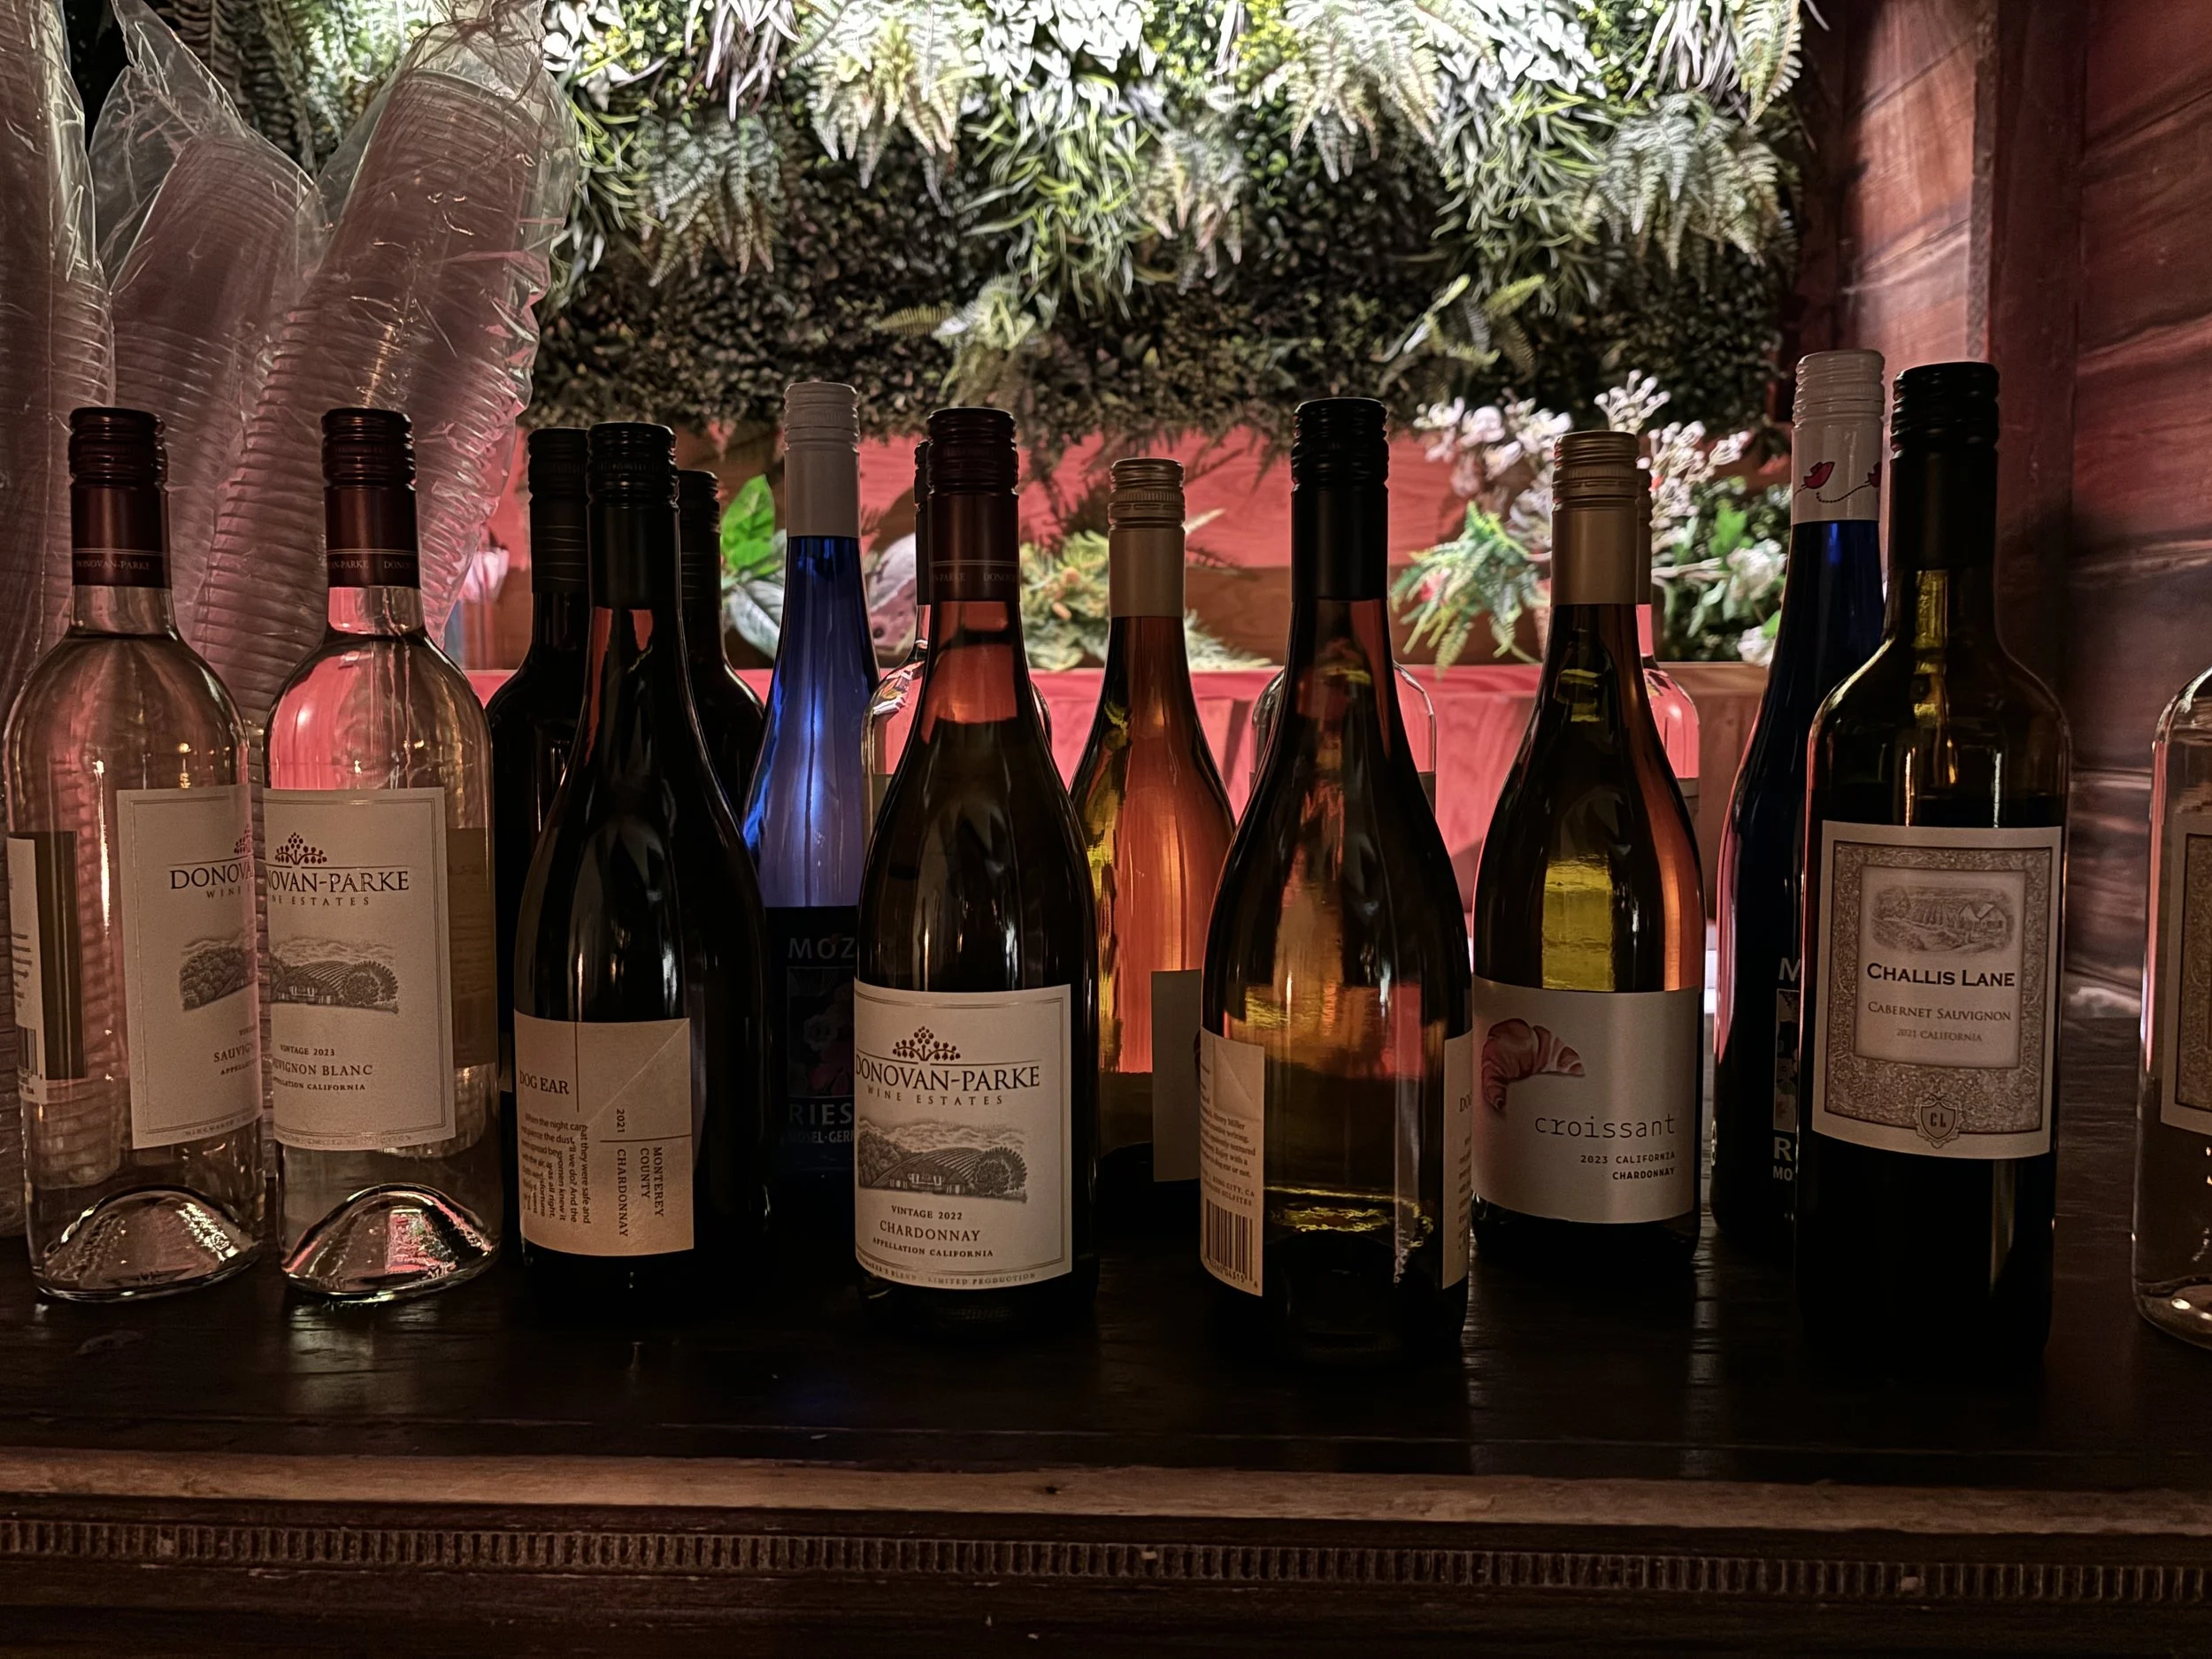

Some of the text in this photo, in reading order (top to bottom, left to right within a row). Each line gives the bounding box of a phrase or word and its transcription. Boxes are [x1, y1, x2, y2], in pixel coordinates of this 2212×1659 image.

[291, 896, 370, 906] ESTATES
[787, 937, 856, 959] MOZ
[1866, 962, 2016, 987] CHALLIS LANE
[1868, 1001, 2012, 1021] CABERNET SAUVIGNON
[1919, 1030, 1983, 1042] CALIFORNIA
[280, 1044, 335, 1056] VINTAGE 2023
[322, 1064, 373, 1076] BLANC
[856, 1054, 1041, 1092] DONOVAN-PARKE
[519, 1070, 570, 1094] DOG EAR
[867, 1085, 1002, 1105] WINE ESTATES
[617, 1109, 626, 1133] 2021
[788, 1103, 853, 1125] RIES
[550, 1121, 569, 1132] night
[1535, 1112, 1675, 1139] croissant
[544, 1133, 556, 1142] the
[569, 1154, 576, 1167] we
[579, 1142, 588, 1163] they
[1580, 1150, 1676, 1164] 2023 CALIFORNIA
[640, 1148, 650, 1199] COUNTY
[654, 1147, 664, 1217] MONTEREY
[1612, 1167, 1675, 1180] CHARDONNAY
[582, 1187, 591, 1205] safe
[618, 1148, 628, 1237] CHARDONNAY
[1245, 1187, 1255, 1197] CA
[582, 1206, 591, 1224] and
[891, 1205, 963, 1221] VINTAGE 2022
[879, 1220, 981, 1242] CHARDONNAY
[872, 1236, 994, 1257] APPELLATION CALIFORNIA
[972, 1272, 1036, 1286] PRODUCTION
